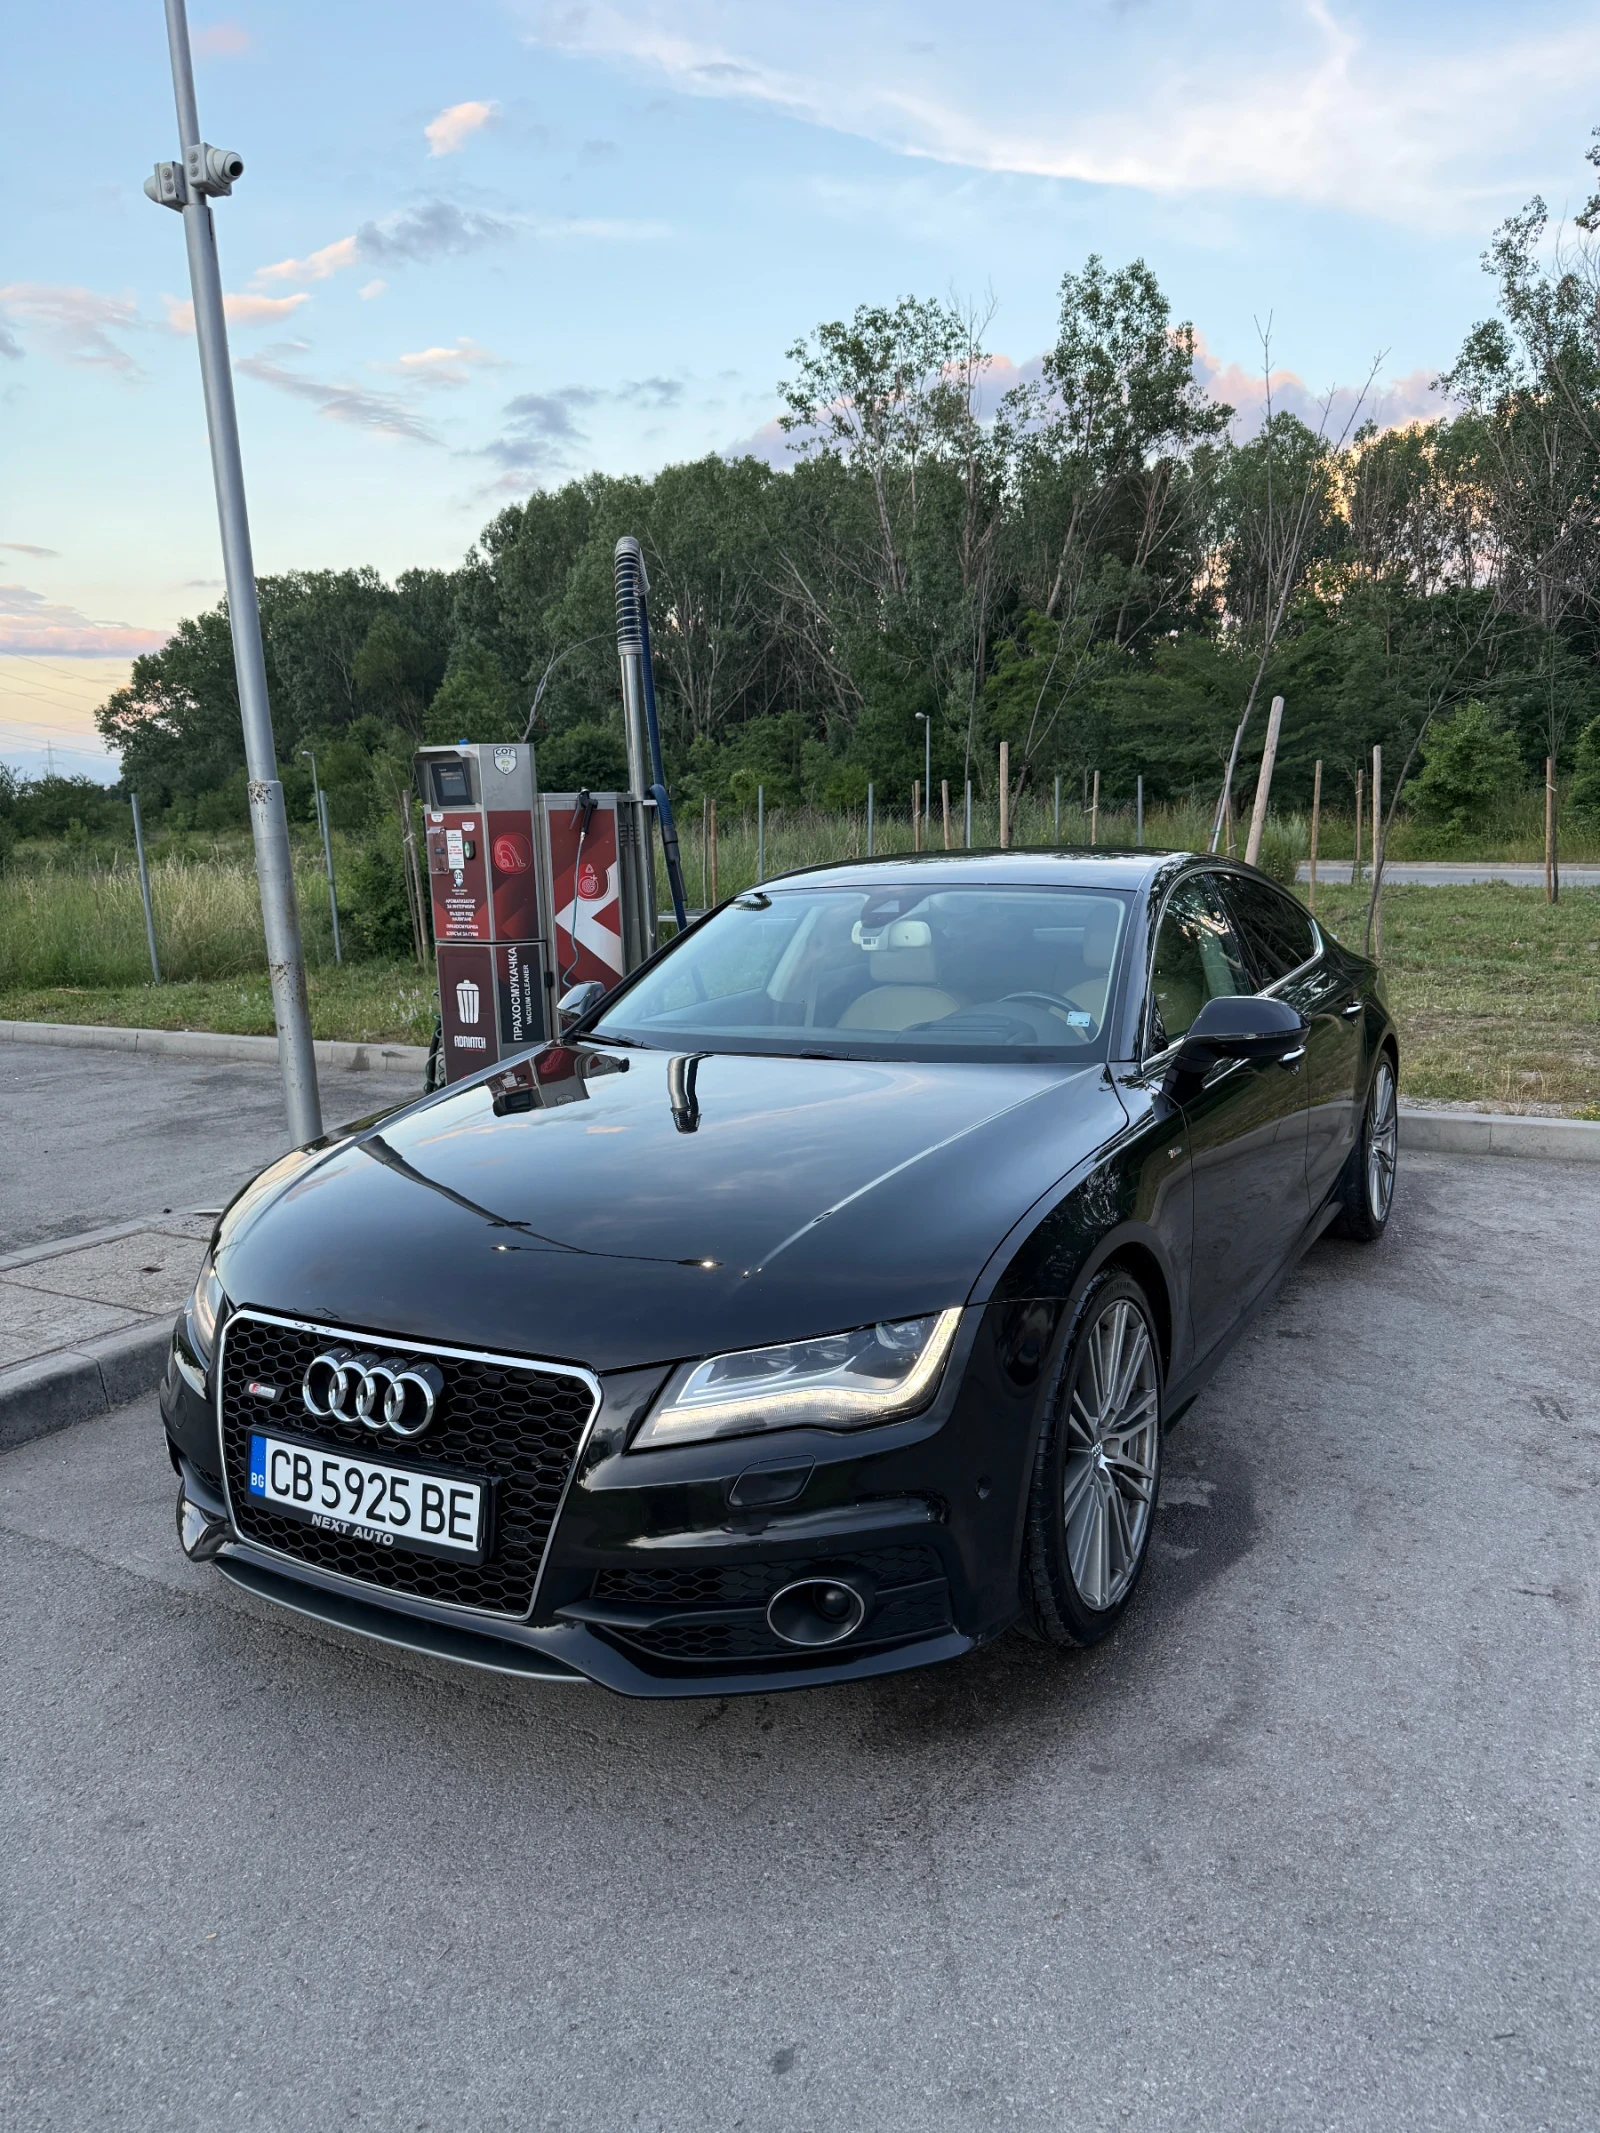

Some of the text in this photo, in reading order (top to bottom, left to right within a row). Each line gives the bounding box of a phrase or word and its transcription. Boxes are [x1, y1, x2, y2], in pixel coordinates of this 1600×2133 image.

[507, 946, 523, 1041] ПРАХОСМУКАЧКА
[523, 964, 531, 996] CLEANER
[250, 1472, 265, 1488] BG
[270, 1448, 474, 1543] CB 5925 BE
[310, 1513, 394, 1546] NEXT AUTO
